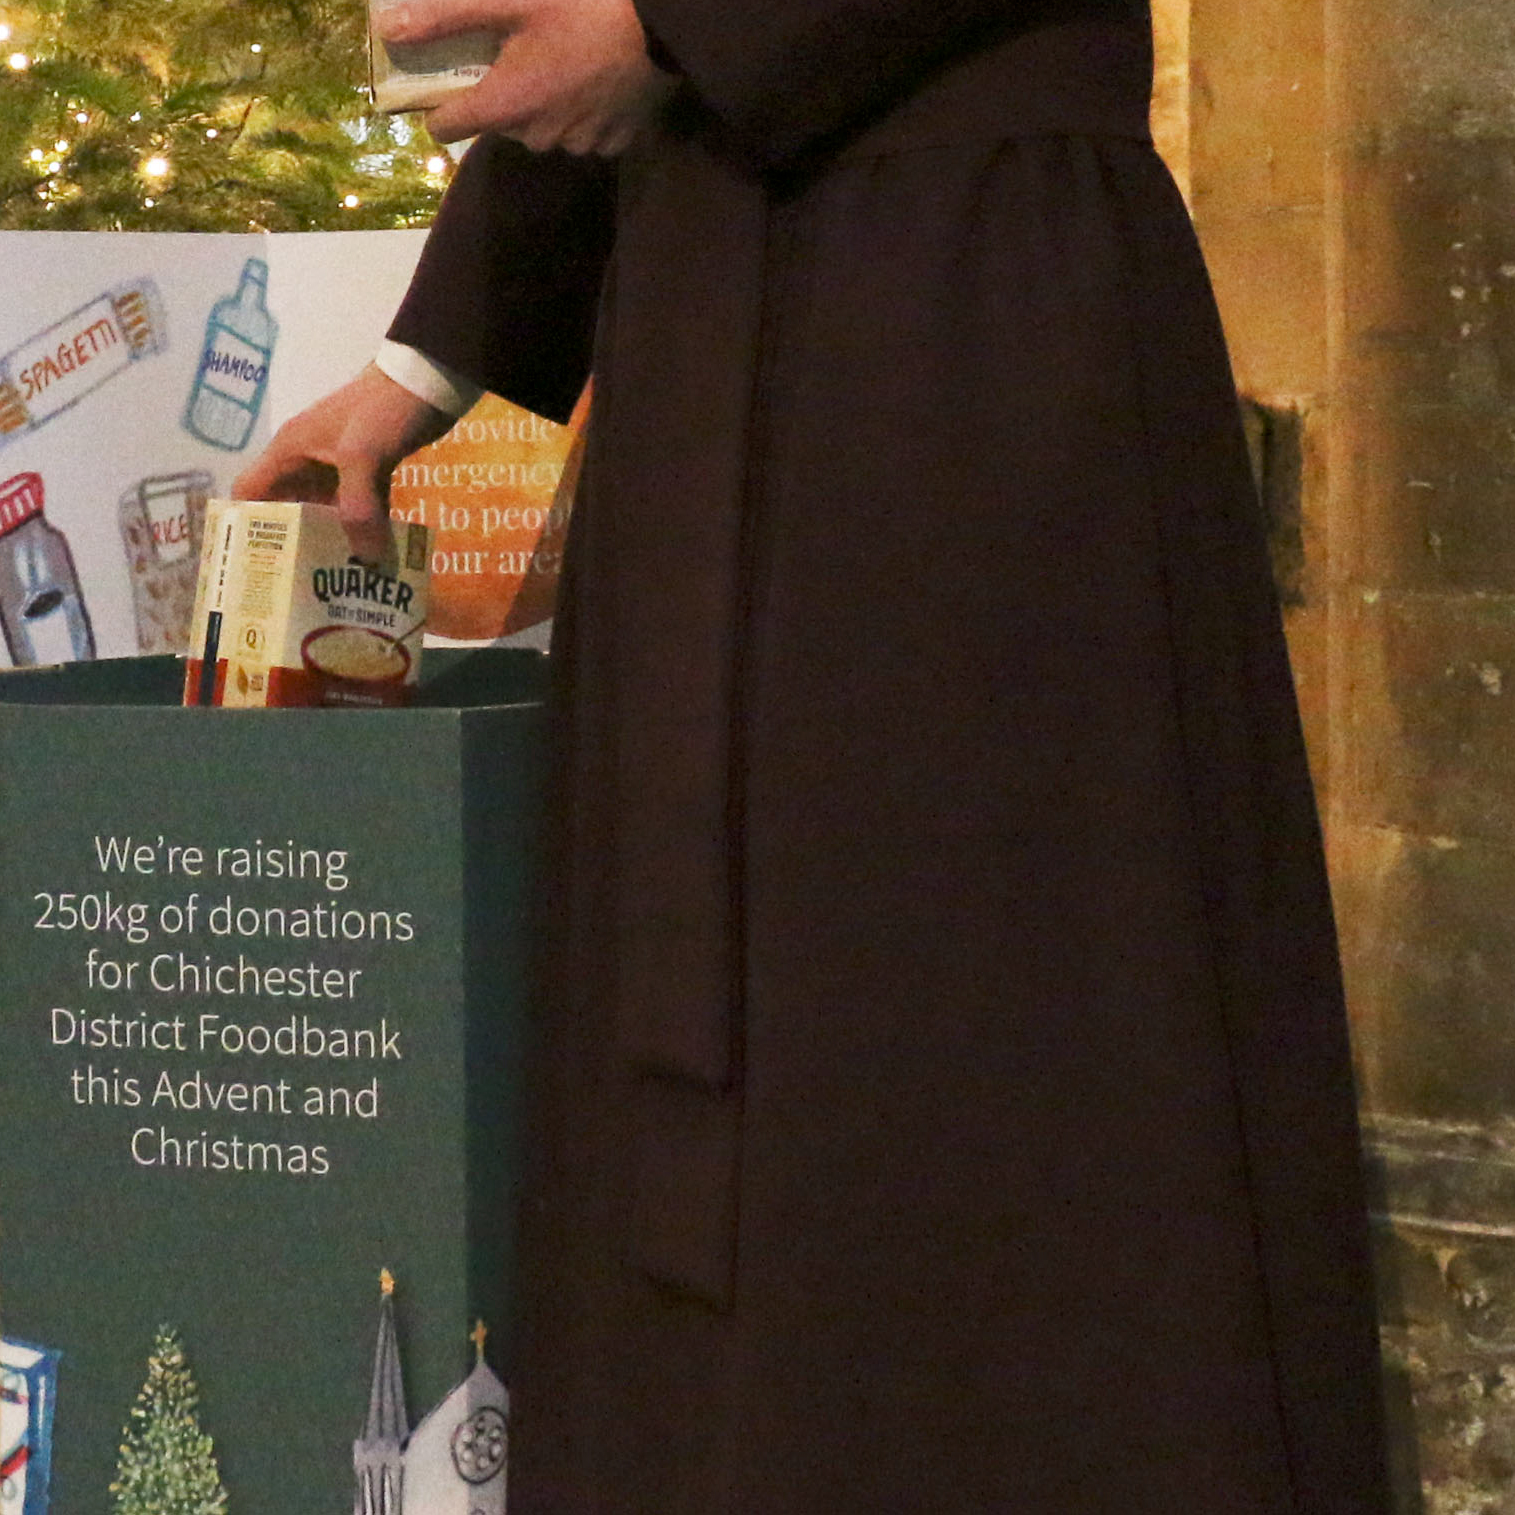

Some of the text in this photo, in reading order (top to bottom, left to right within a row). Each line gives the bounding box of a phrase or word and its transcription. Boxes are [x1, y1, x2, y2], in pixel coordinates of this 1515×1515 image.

[19, 317, 120, 400] SPAGETTI
[203, 347, 267, 384] SHAMPOO
[152, 514, 189, 546] RICE
[439, 502, 471, 531] to
[481, 495, 573, 538] peopl
[432, 550, 490, 575] our
[312, 566, 414, 613] QUAKER
[327, 603, 348, 620] OAT
[356, 606, 396, 628] SIMPLE
[94, 834, 350, 891] We're raising
[32, 892, 415, 944] 250kg of donations
[85, 947, 363, 1000] for Chichester
[50, 1007, 403, 1060] District Foodbank
[70, 1065, 379, 1119] this Advent and
[130, 1127, 330, 1175] Christmas
